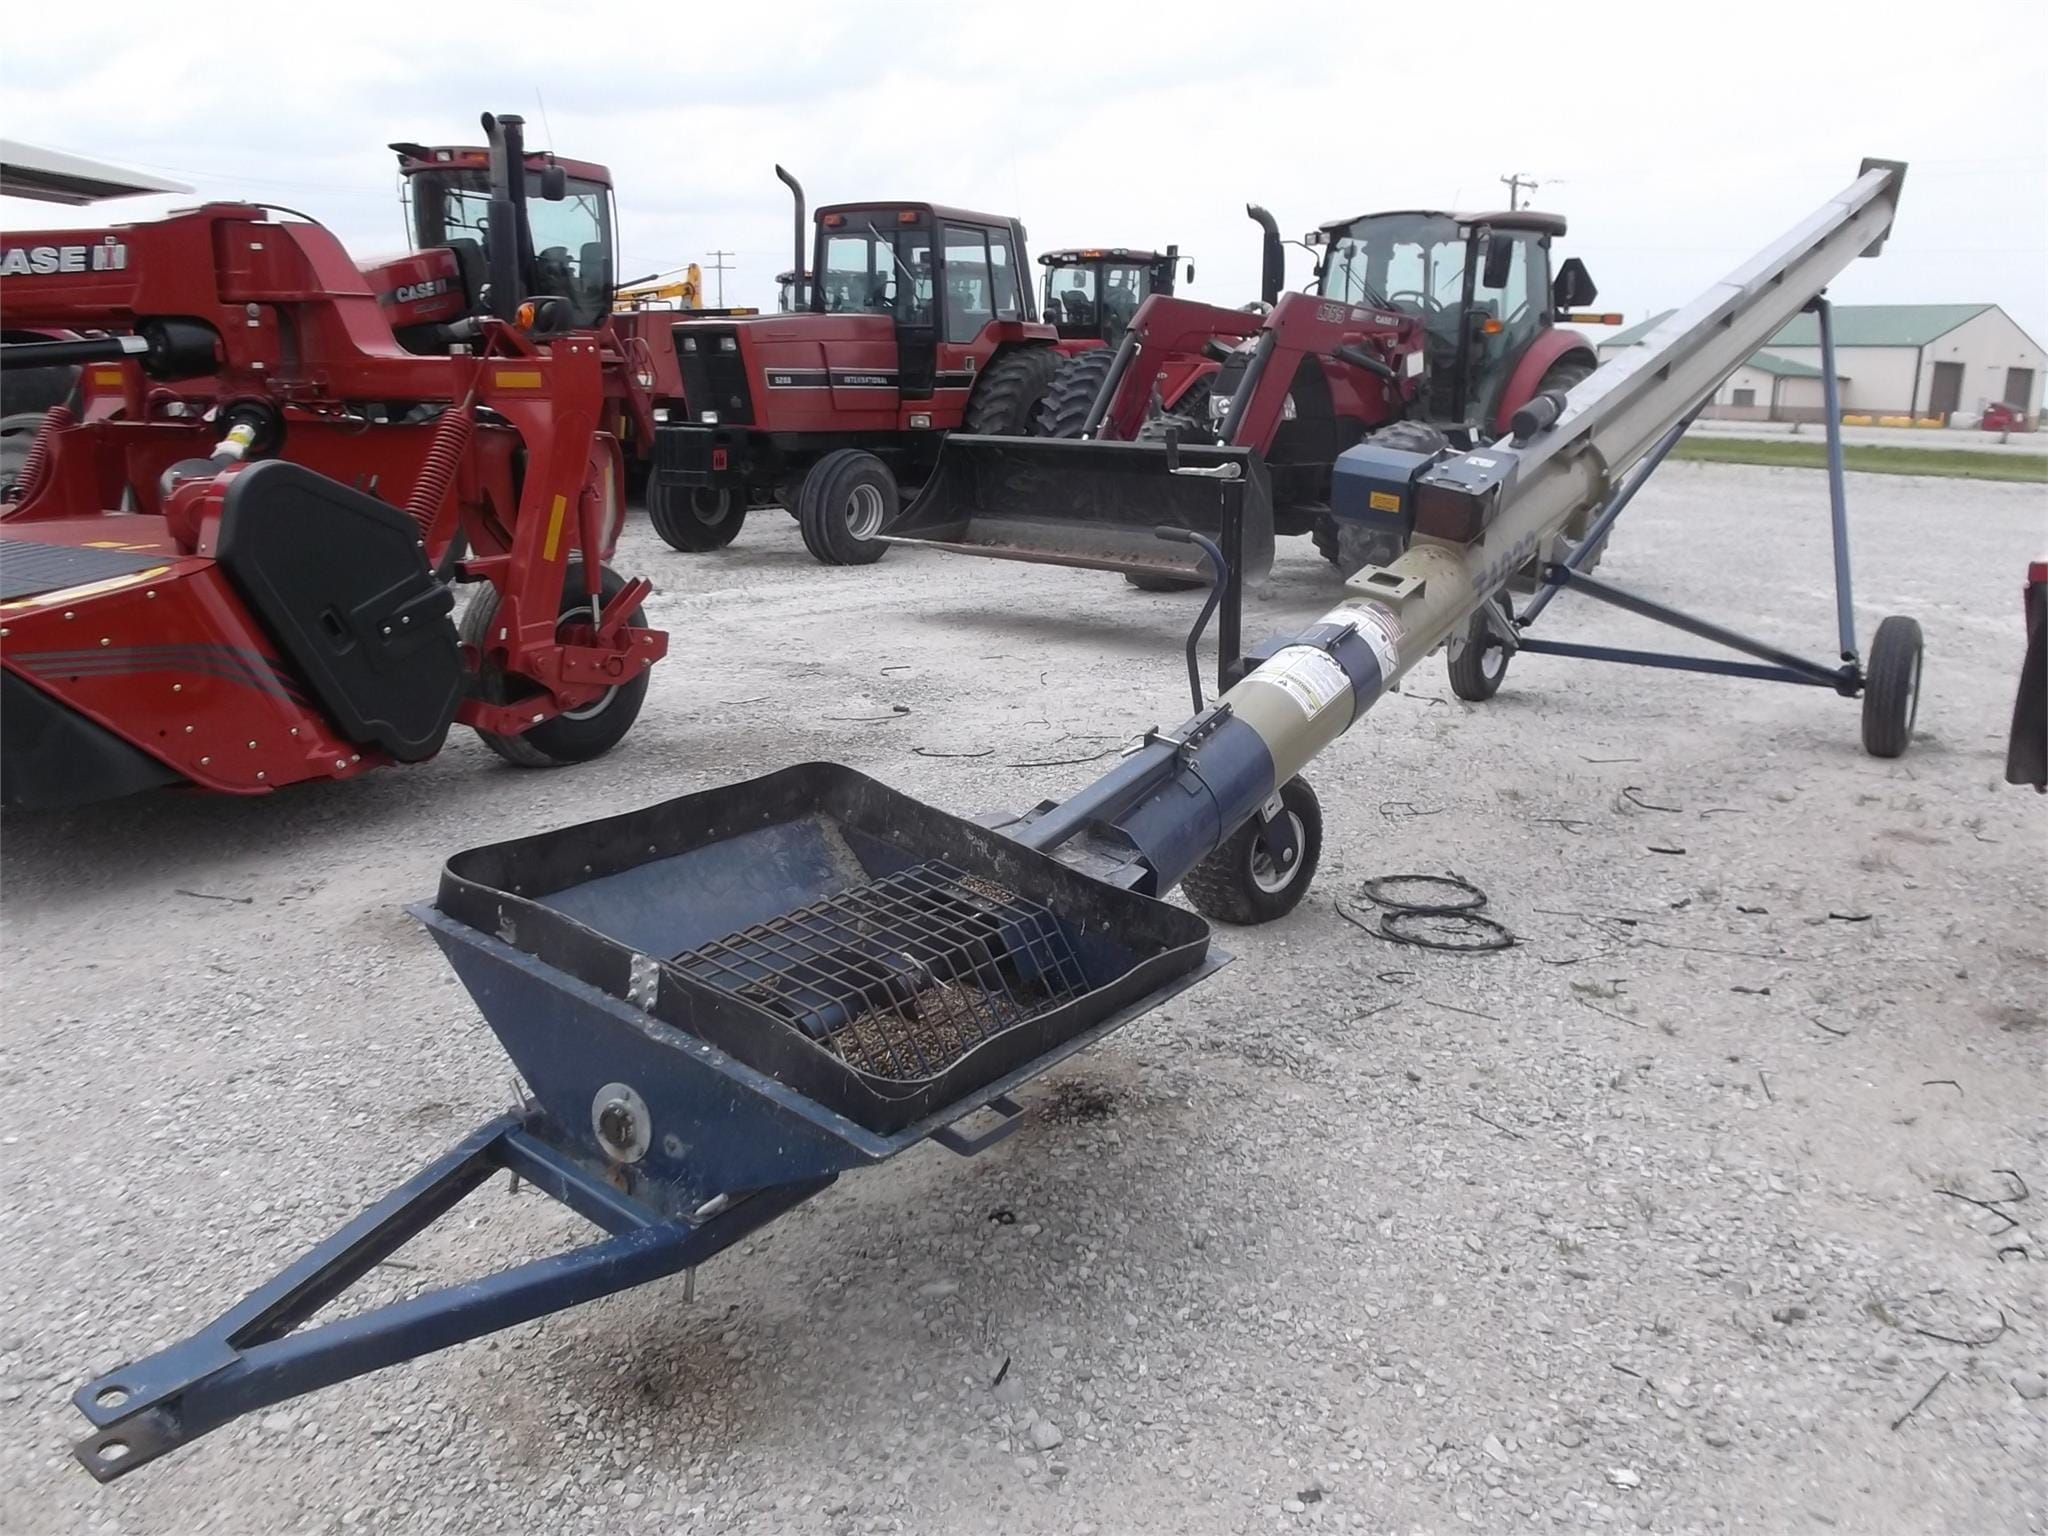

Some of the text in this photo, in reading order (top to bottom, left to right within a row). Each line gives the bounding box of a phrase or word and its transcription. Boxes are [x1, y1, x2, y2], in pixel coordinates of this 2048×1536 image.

[0, 246, 86, 275] ASE
[396, 281, 436, 303] CASE
[1316, 303, 1345, 324] L755
[844, 376, 888, 385] INTERNATIONAL
[1285, 673, 1312, 695] CAUTION
